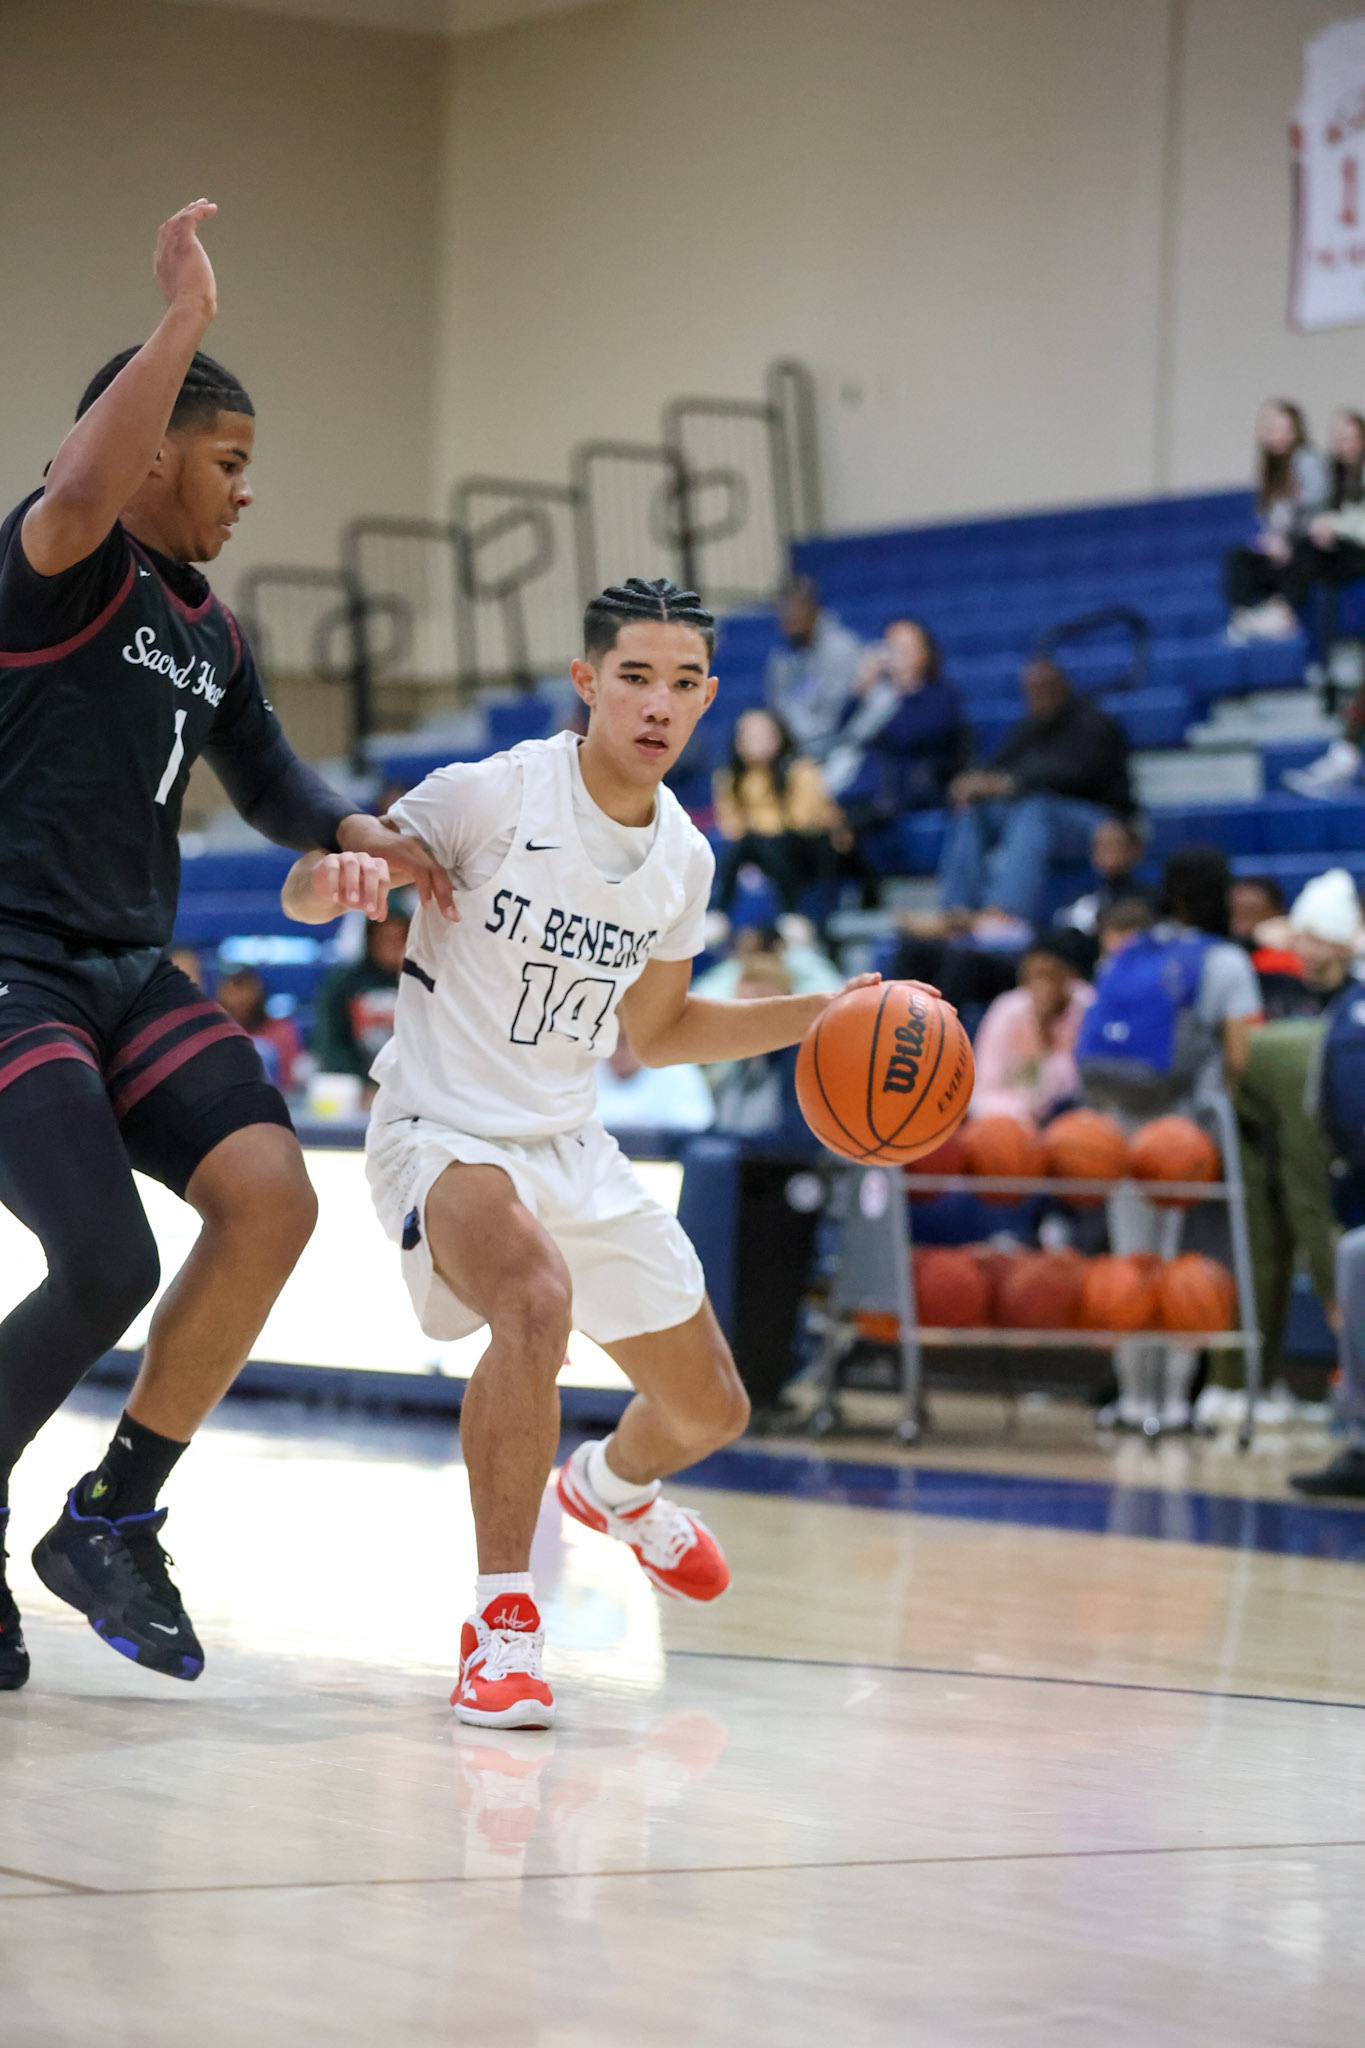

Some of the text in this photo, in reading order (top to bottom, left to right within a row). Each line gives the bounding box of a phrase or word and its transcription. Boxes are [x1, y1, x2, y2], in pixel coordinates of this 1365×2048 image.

[122, 626, 227, 708] Sacrd Hea
[154, 708, 188, 806] 1
[484, 889, 658, 968] ST. BENEDIC
[509, 962, 617, 1051] 14
[883, 993, 928, 1094] Wilson
